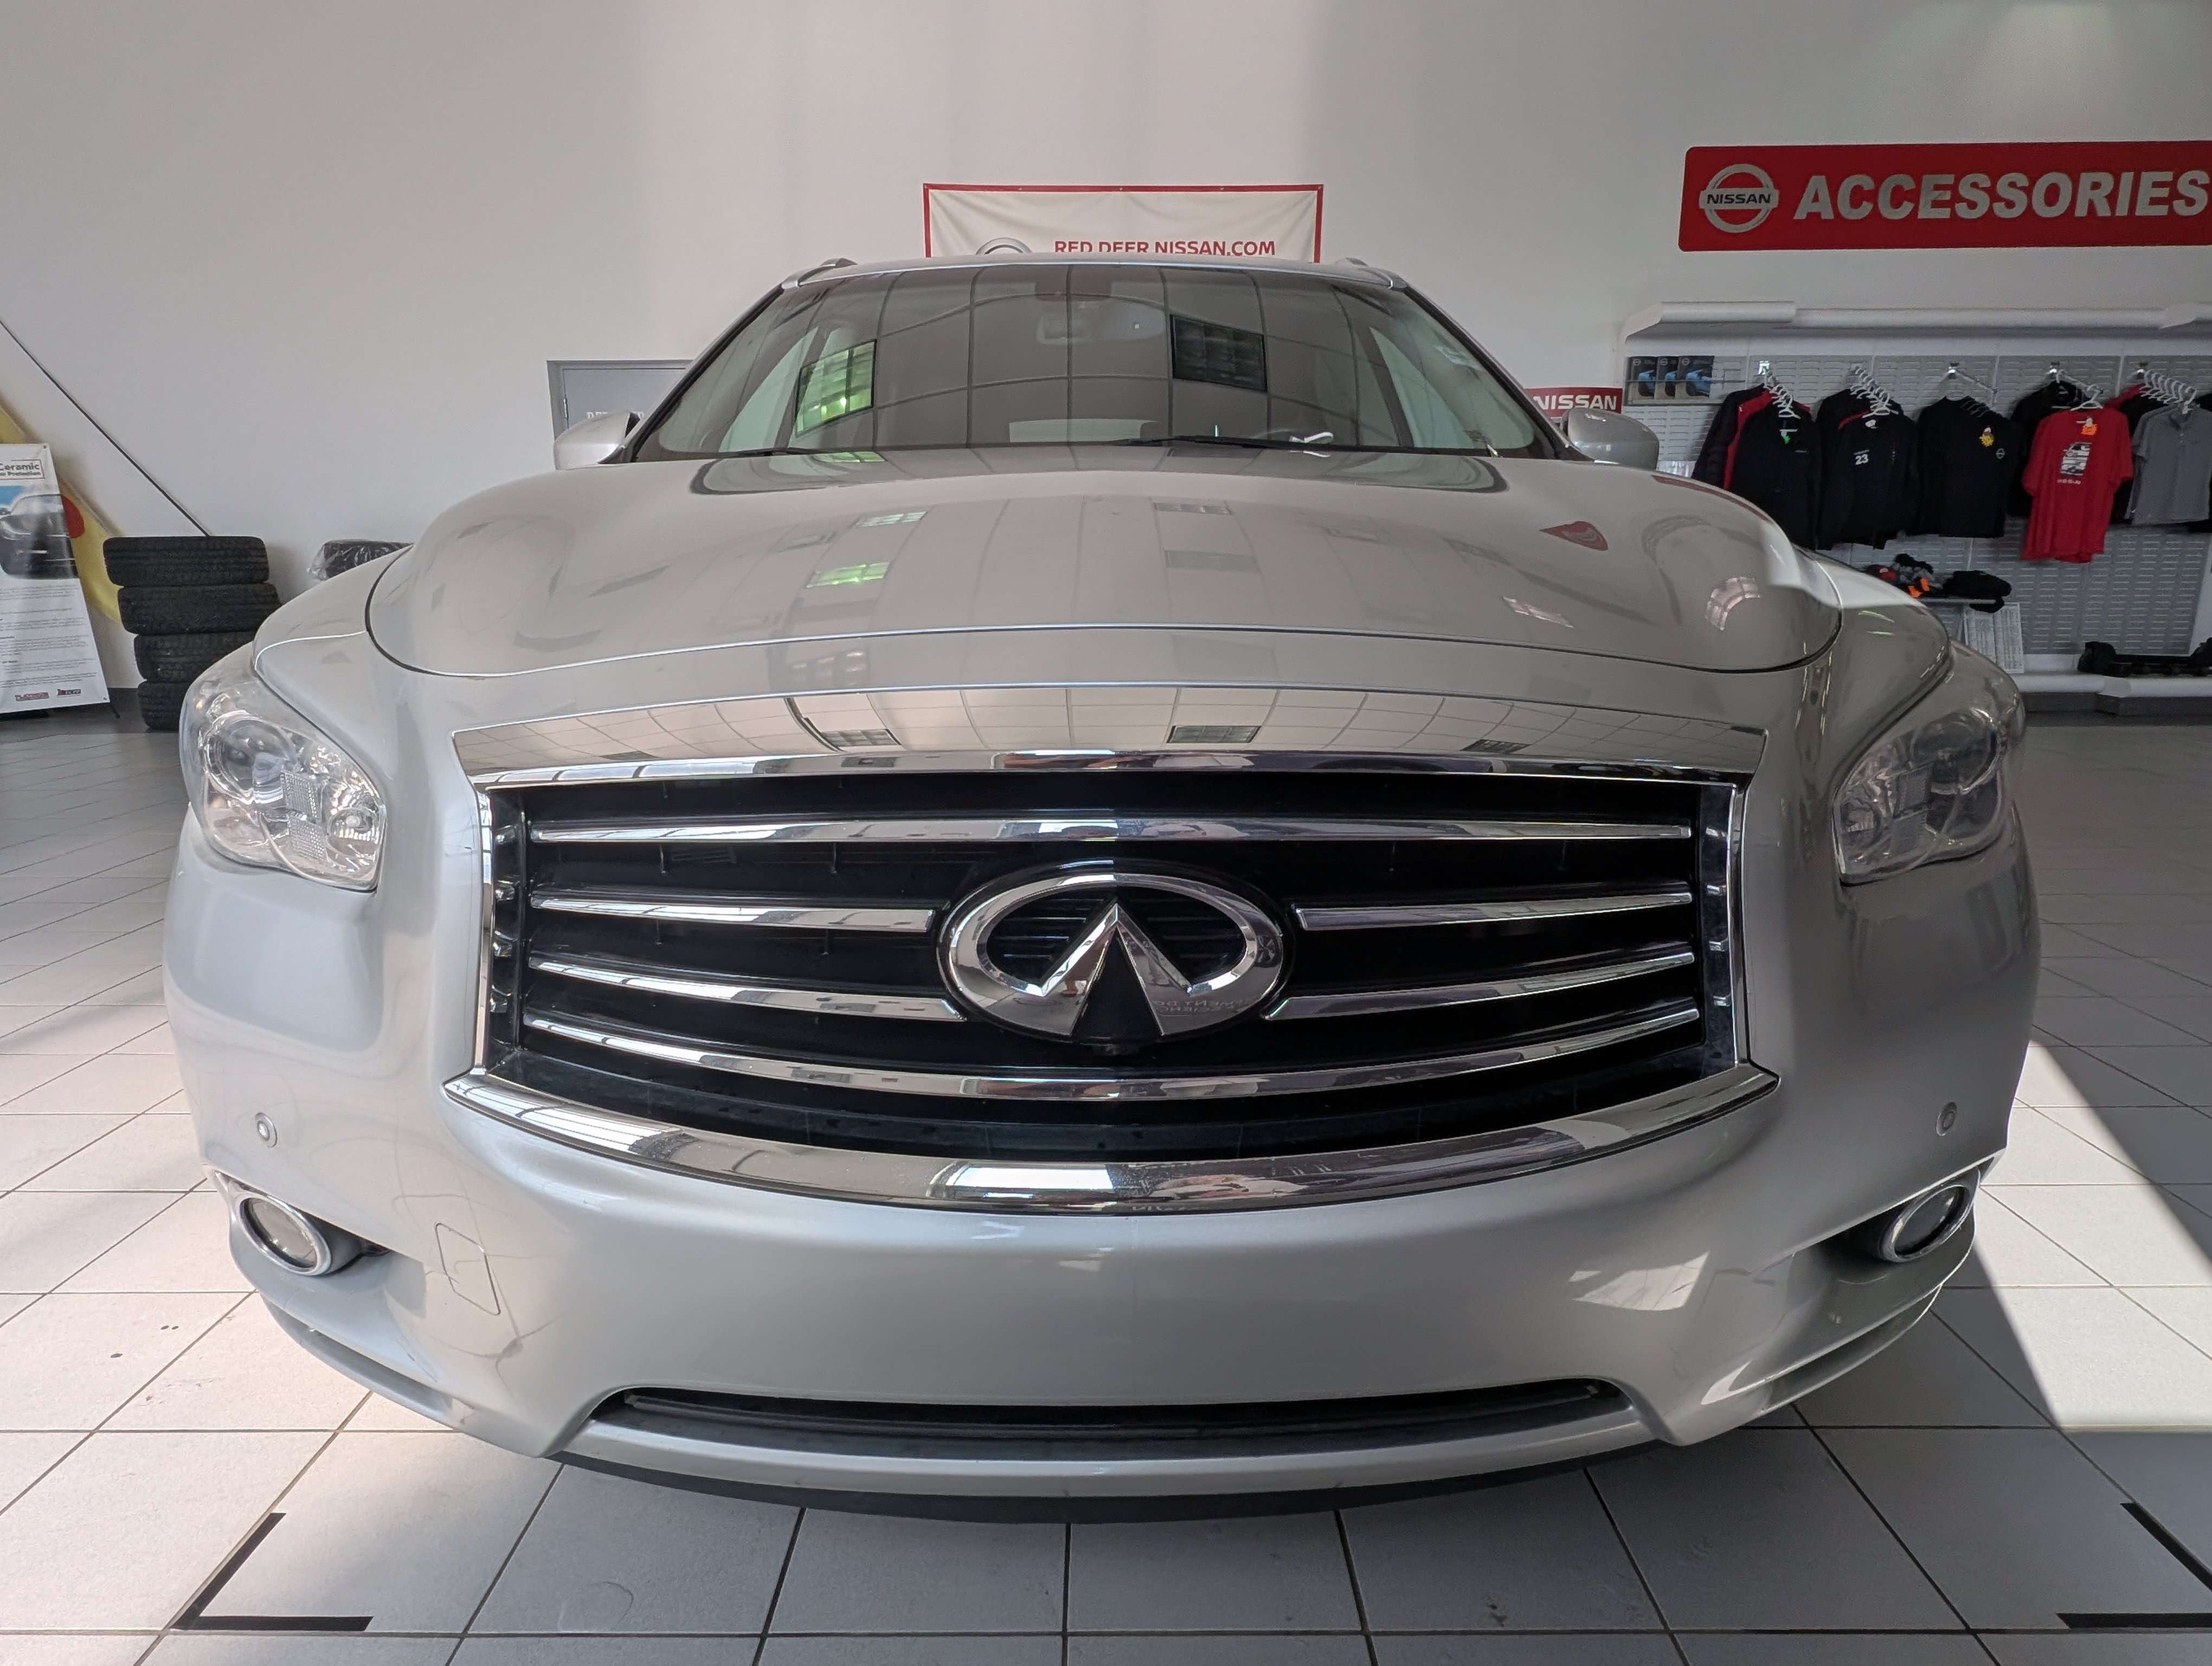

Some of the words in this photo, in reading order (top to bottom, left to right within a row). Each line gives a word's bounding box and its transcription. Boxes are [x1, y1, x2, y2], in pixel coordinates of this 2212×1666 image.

[1707, 194, 1771, 204] NISSAN
[1792, 170, 2210, 220] ACCESSORIES
[1054, 241, 1093, 252] RED
[1099, 241, 1149, 253] DEER
[1155, 241, 1275, 257] NISSAN.COM
[1533, 394, 1617, 411] NISSAN
[1855, 453, 1869, 465] 23
